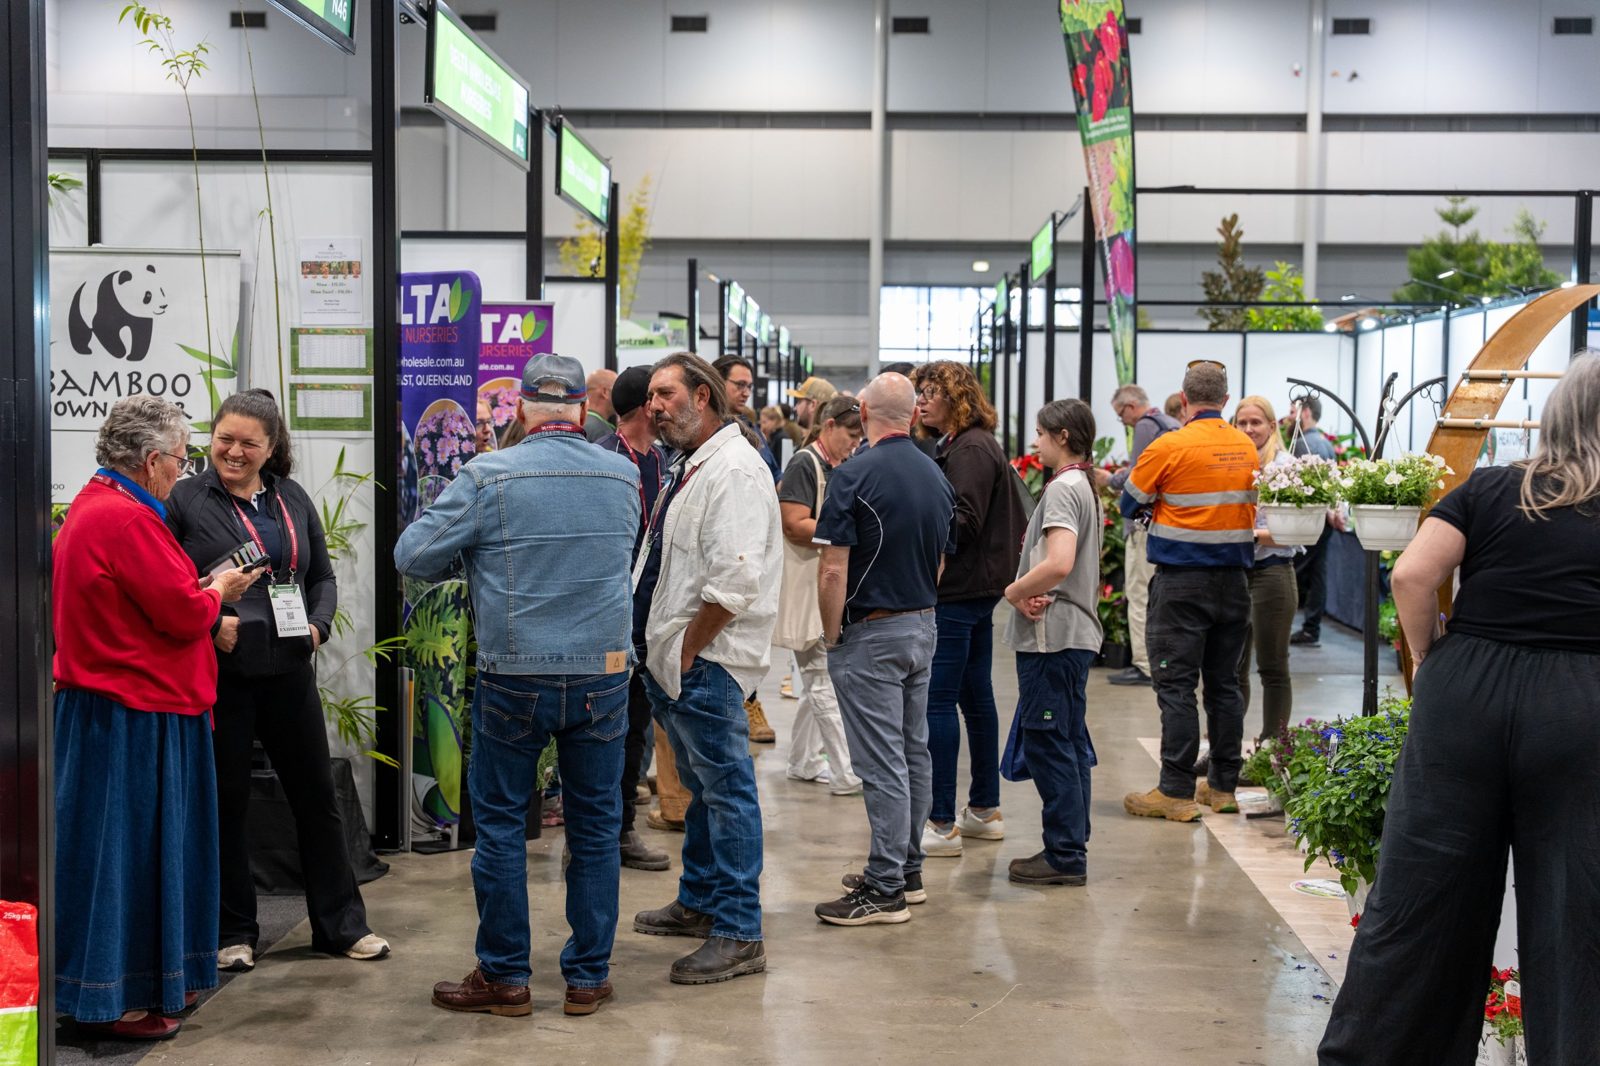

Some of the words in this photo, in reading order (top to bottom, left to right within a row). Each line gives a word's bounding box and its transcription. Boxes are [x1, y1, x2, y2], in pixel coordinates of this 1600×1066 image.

[331, 0, 348, 22] N46
[405, 326, 459, 343] NURSERIES
[415, 374, 473, 386] QUEENSLAND
[3, 911, 21, 922] 25kg
